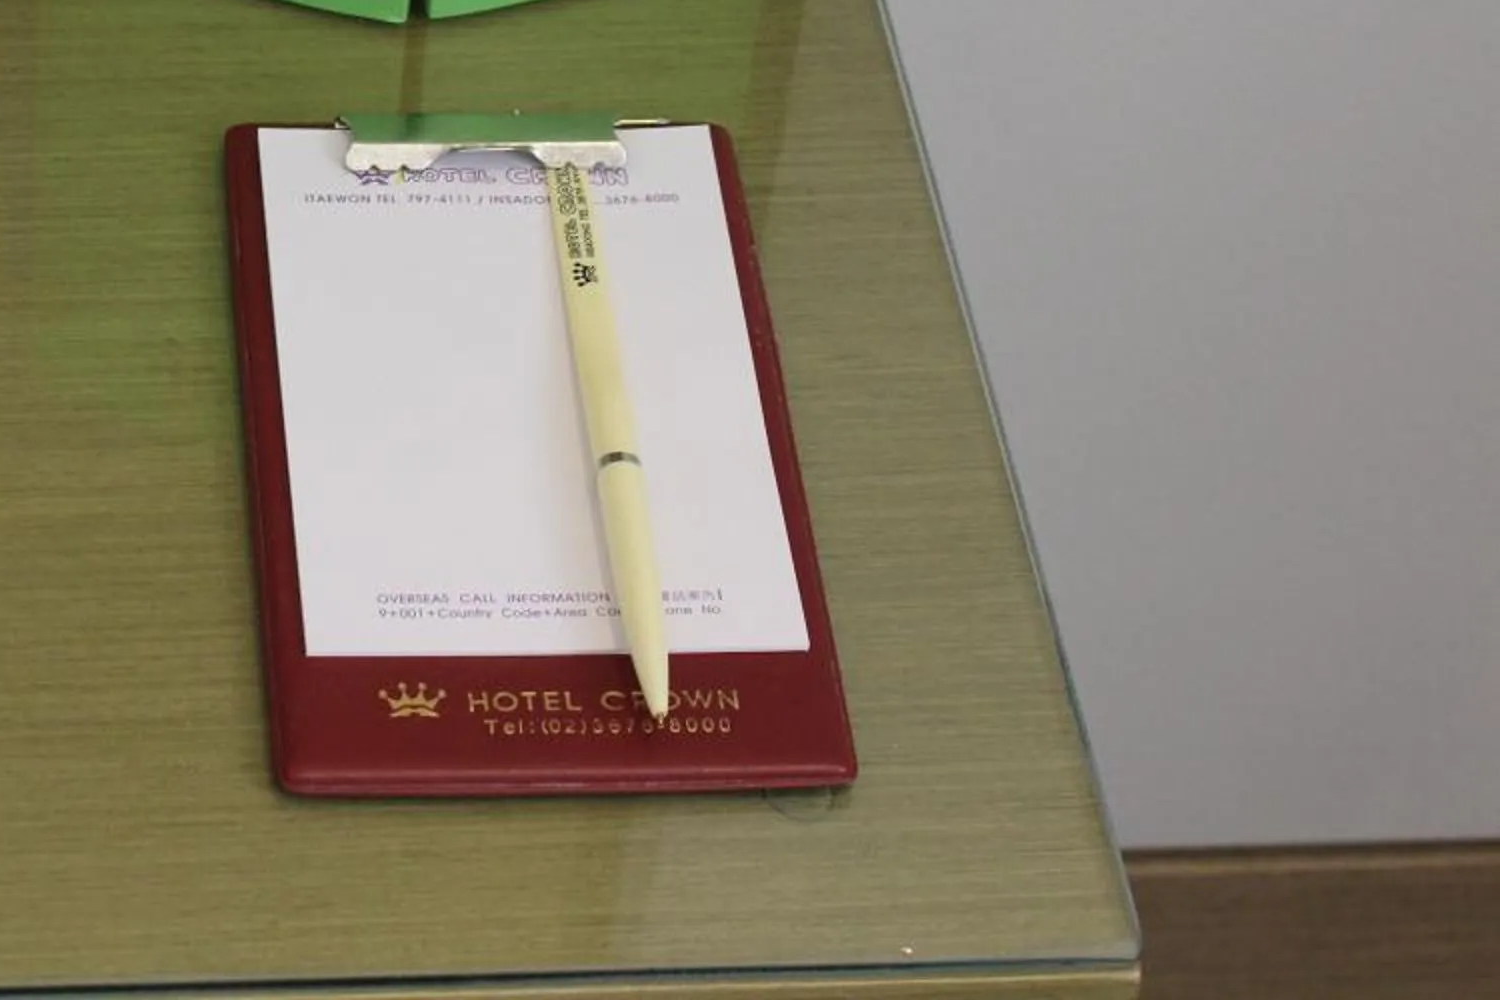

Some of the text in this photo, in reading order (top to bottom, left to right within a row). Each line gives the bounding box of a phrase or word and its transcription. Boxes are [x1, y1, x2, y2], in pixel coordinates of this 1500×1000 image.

[402, 165, 629, 186] HOTEL CRWN
[304, 194, 371, 204] ITAEWON
[377, 591, 611, 604] OVERSEAS CALL INFORMATION
[378, 607, 492, 619] 9+001+Country
[501, 606, 587, 618] Code+Area
[467, 690, 583, 713] HOTEL
